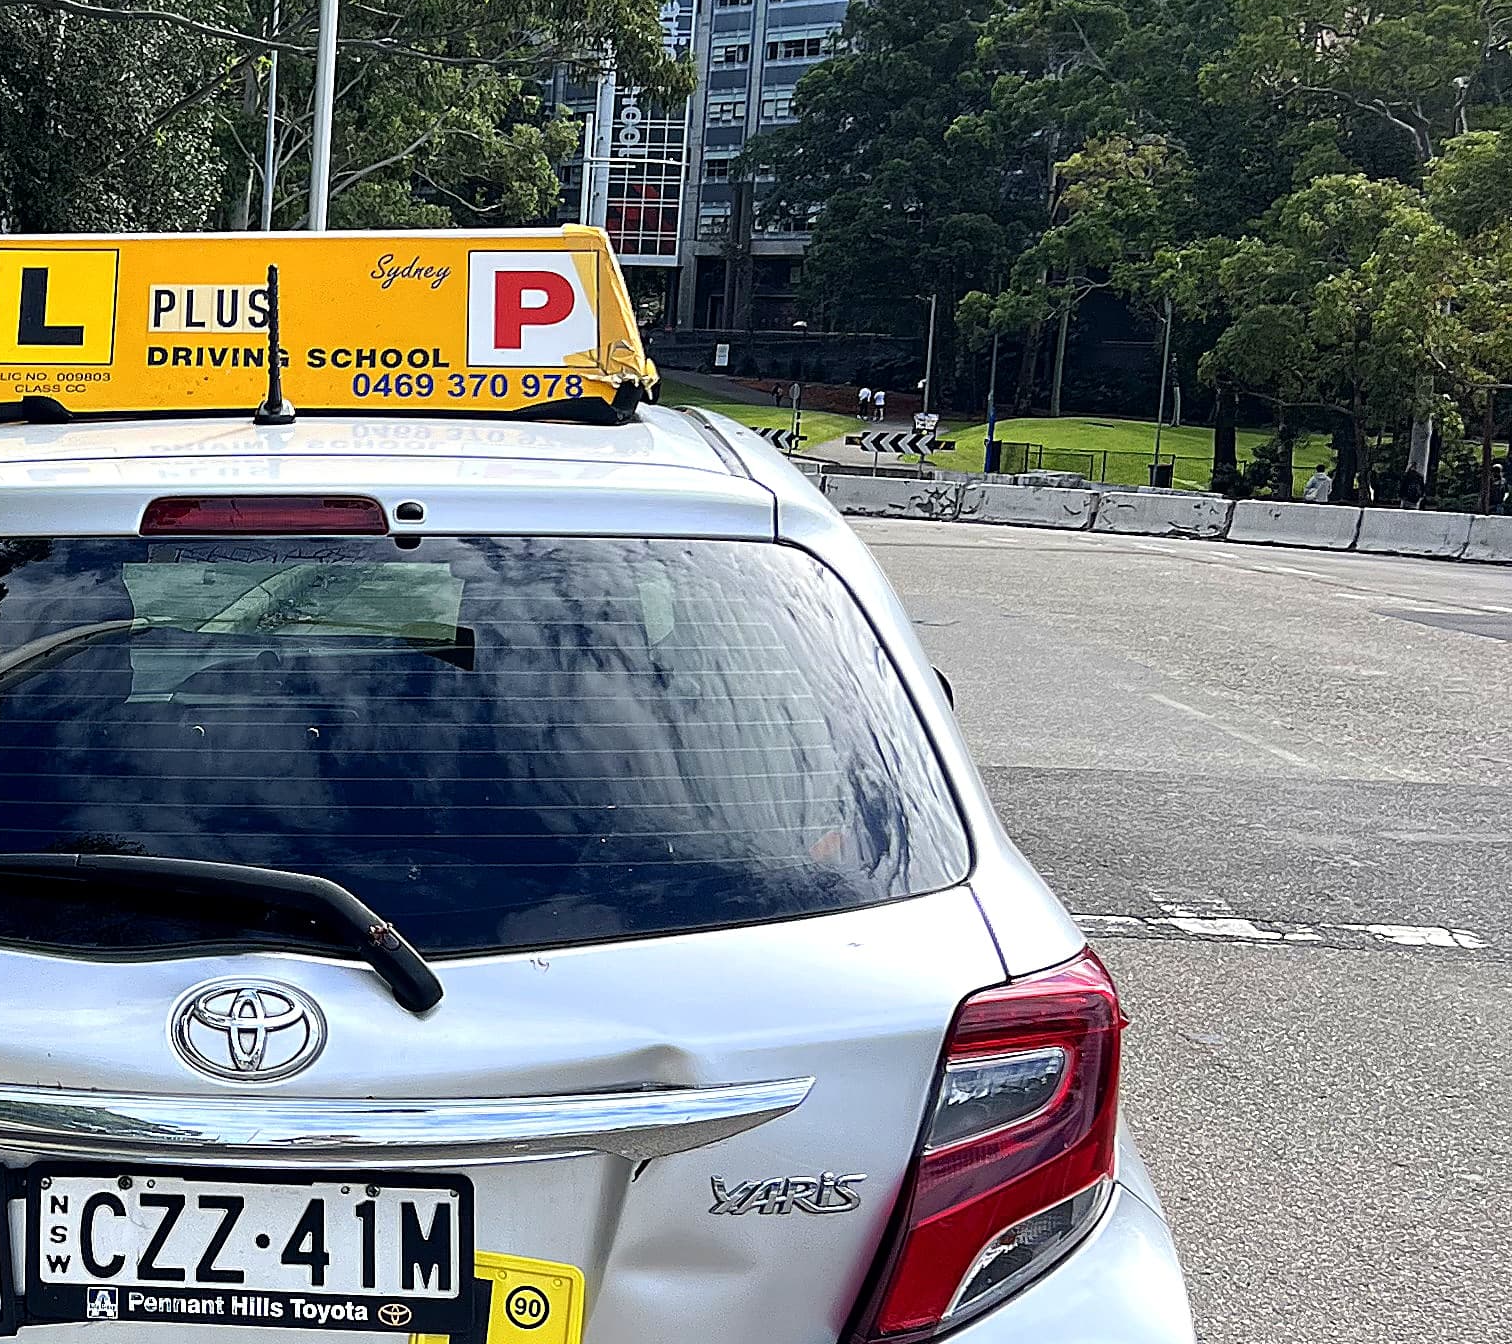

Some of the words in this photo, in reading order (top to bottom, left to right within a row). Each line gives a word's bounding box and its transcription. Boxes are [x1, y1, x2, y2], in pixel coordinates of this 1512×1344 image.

[370, 254, 452, 289] Sydney
[17, 267, 85, 346] L
[152, 289, 269, 328] PLUS
[494, 270, 575, 350] P
[307, 348, 450, 369] SCHOOL
[0, 372, 22, 381] LIC
[56, 372, 111, 382] 009803
[14, 384, 61, 393] CLASS
[352, 373, 435, 398] 0469
[447, 374, 509, 398] 370
[521, 374, 584, 399] 978
[128, 1292, 226, 1315] Pennant
[231, 1295, 284, 1318] Hills
[289, 1298, 369, 1324] Toyota
[514, 1297, 541, 1318] 90
